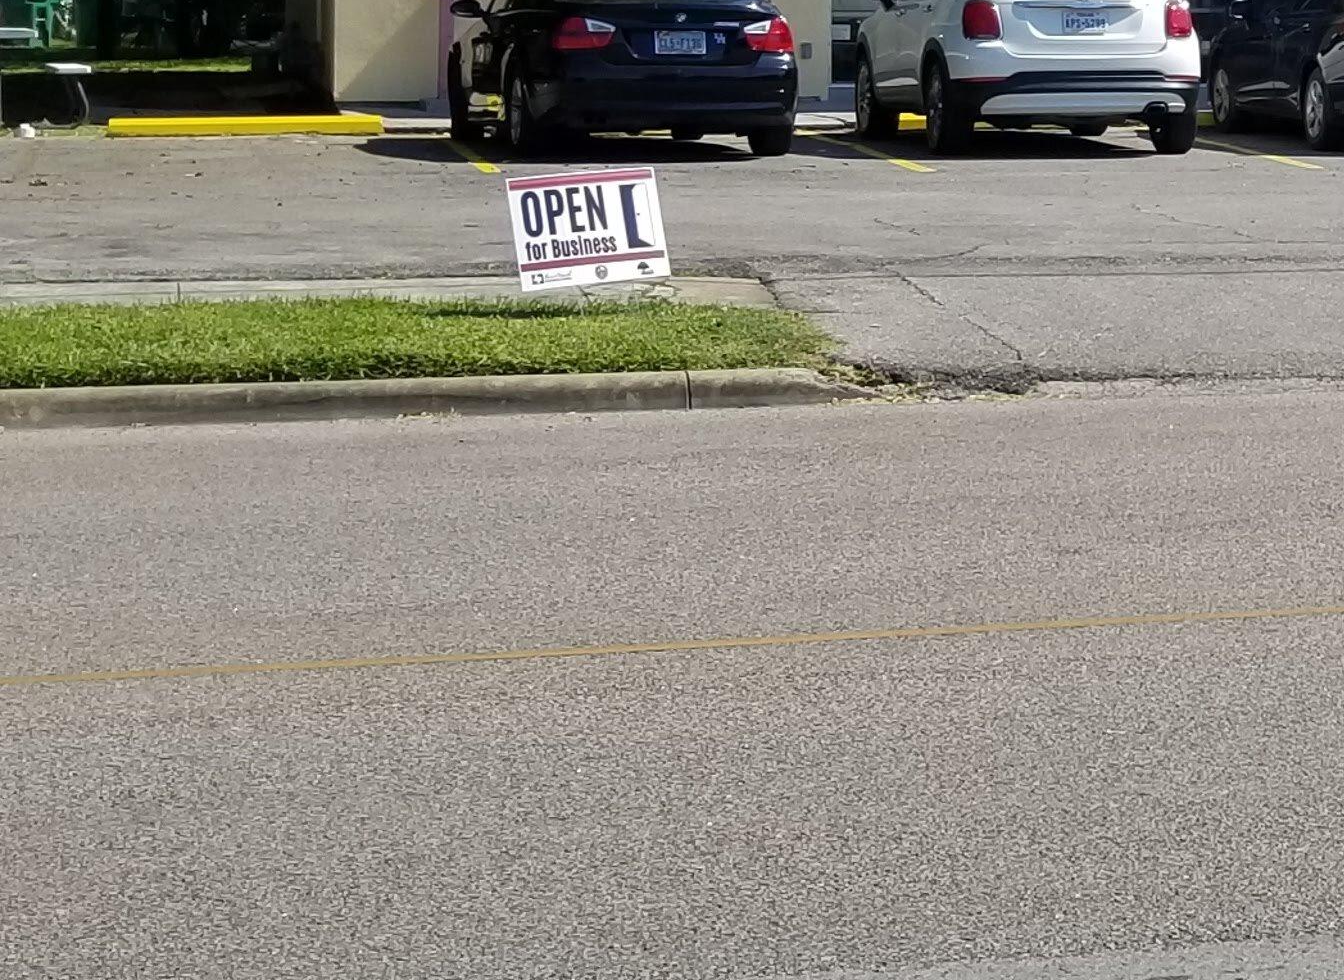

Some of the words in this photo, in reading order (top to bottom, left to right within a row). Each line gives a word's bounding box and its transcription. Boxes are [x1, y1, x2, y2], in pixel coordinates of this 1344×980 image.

[520, 185, 608, 238] OPEN
[525, 242, 548, 261] for
[552, 235, 618, 259] Business
